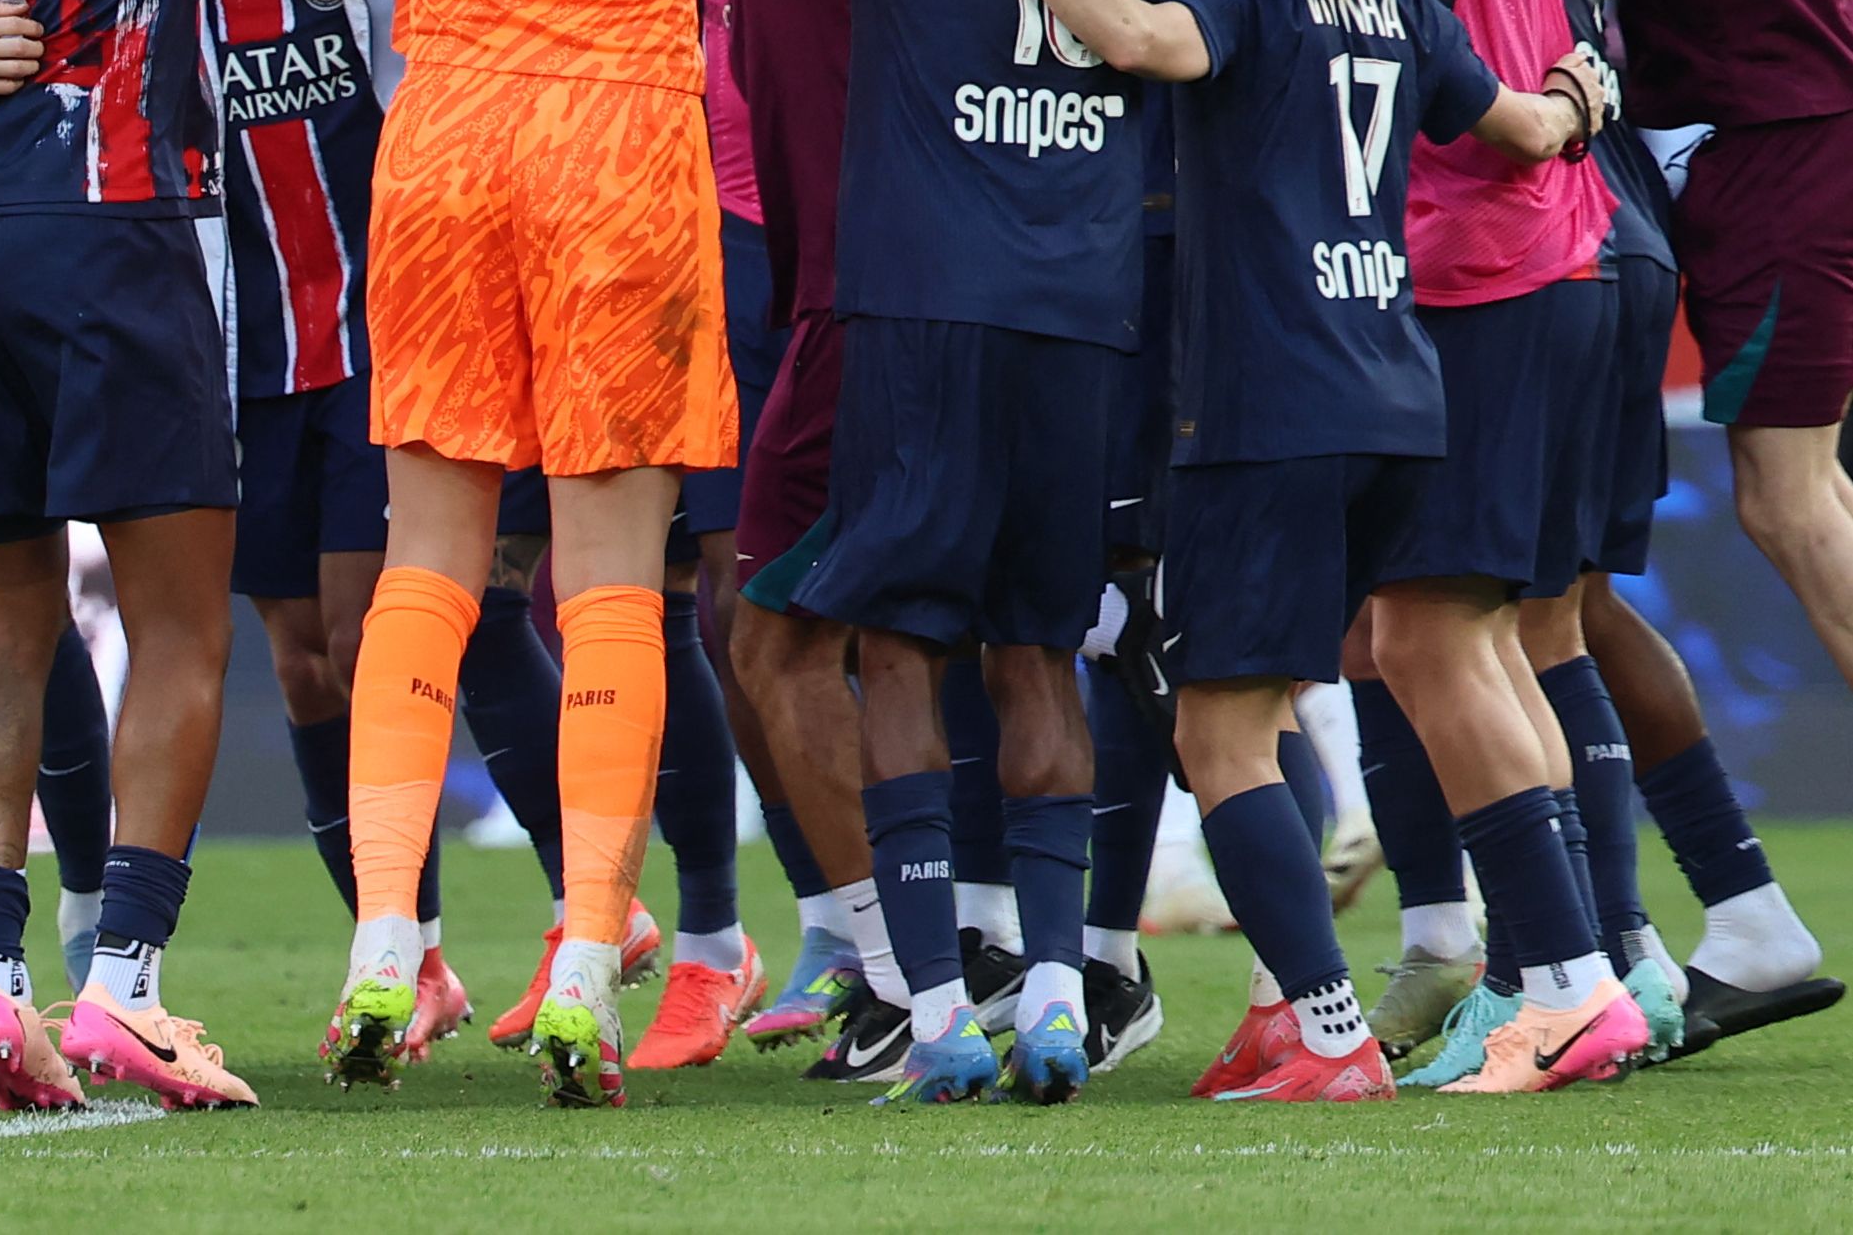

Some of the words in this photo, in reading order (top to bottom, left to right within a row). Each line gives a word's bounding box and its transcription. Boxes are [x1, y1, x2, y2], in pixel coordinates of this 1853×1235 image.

[228, 72, 357, 122] AIRWAYS
[954, 83, 1105, 159] snipes
[1329, 52, 1402, 217] 17
[566, 689, 616, 711] PARIS
[900, 860, 950, 882] PARIS
